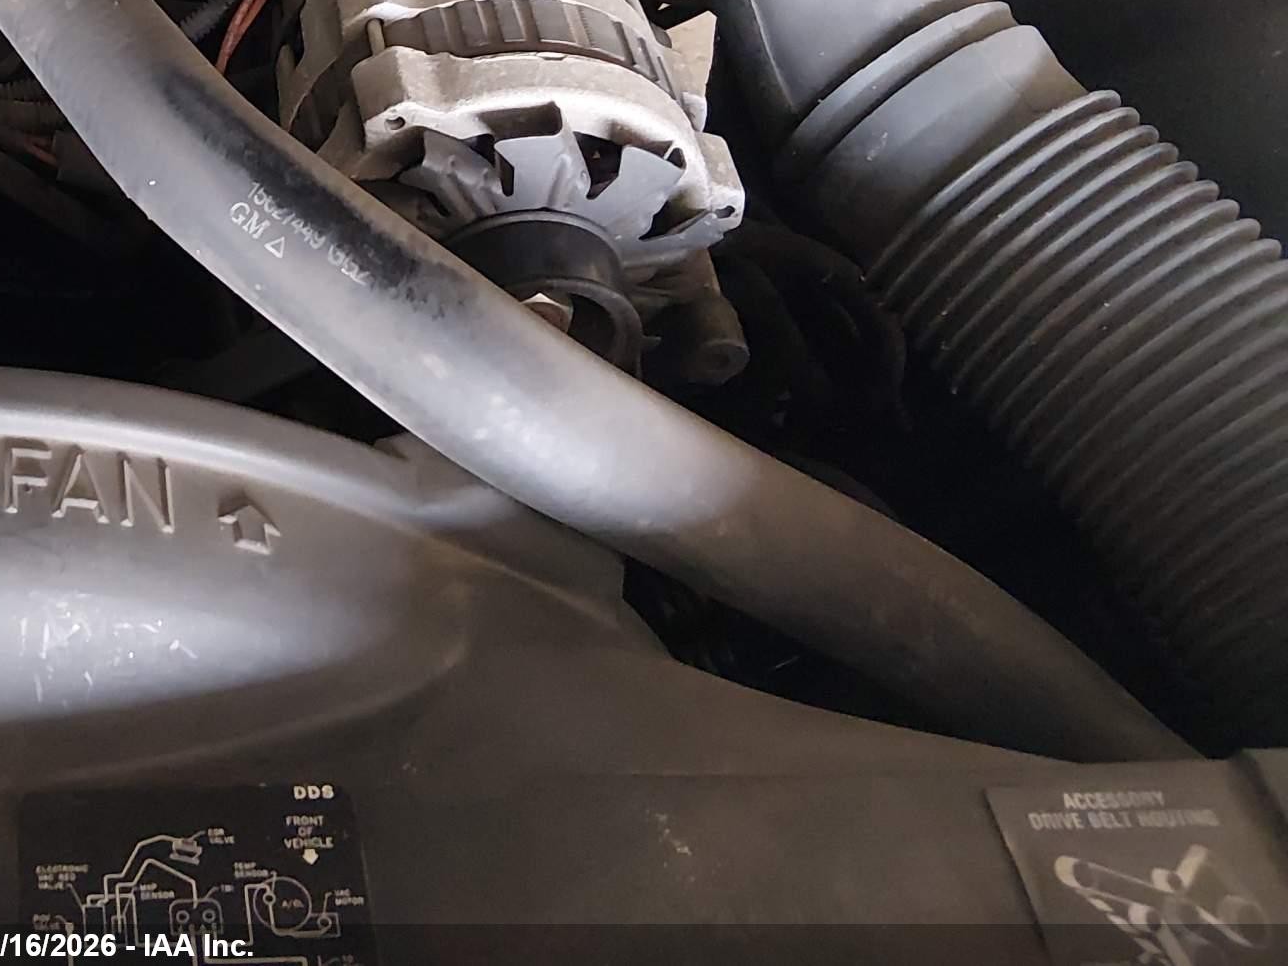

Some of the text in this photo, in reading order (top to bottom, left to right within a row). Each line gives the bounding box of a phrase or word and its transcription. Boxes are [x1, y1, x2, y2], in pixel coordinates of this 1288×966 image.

[229, 201, 270, 240] GM
[1063, 791, 1165, 810] ACCESSORY
[285, 815, 325, 827] FRONT
[1028, 812, 1085, 831] DRIVE
[1087, 811, 1133, 829] BELT
[297, 827, 313, 836] OF
[283, 837, 334, 849] VEHICLE
